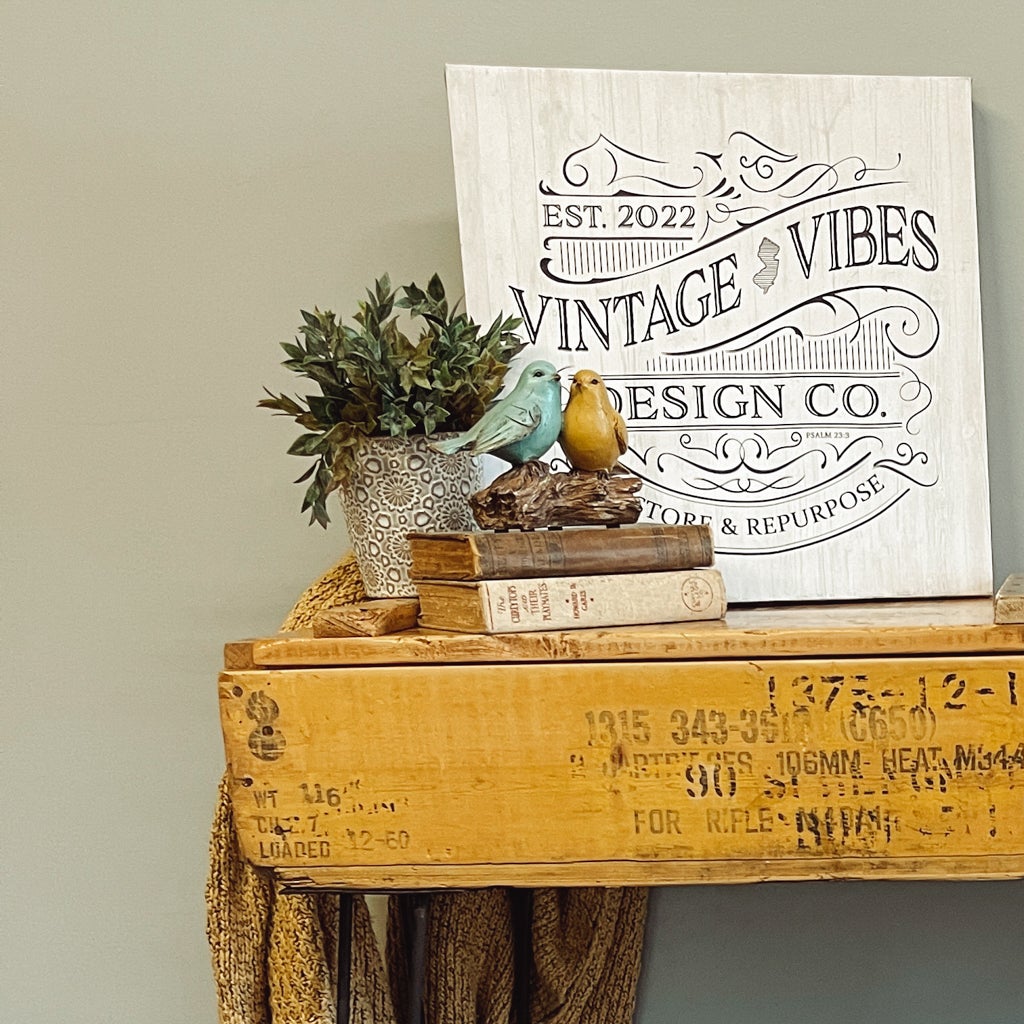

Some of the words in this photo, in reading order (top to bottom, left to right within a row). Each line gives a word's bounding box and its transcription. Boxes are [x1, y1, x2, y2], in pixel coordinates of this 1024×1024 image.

[542, 203, 608, 228] EST.
[617, 203, 696, 229] 2022
[508, 253, 742, 352] VINTAGE
[787, 204, 939, 279] VIBES
[804, 382, 888, 419] CO.
[806, 431, 832, 439] PSALM
[721, 517, 738, 535] &
[746, 473, 885, 535] REPURPOSE
[529, 588, 540, 616] THEIR
[634, 809, 682, 834] FOR
[259, 840, 331, 860] LOADED
